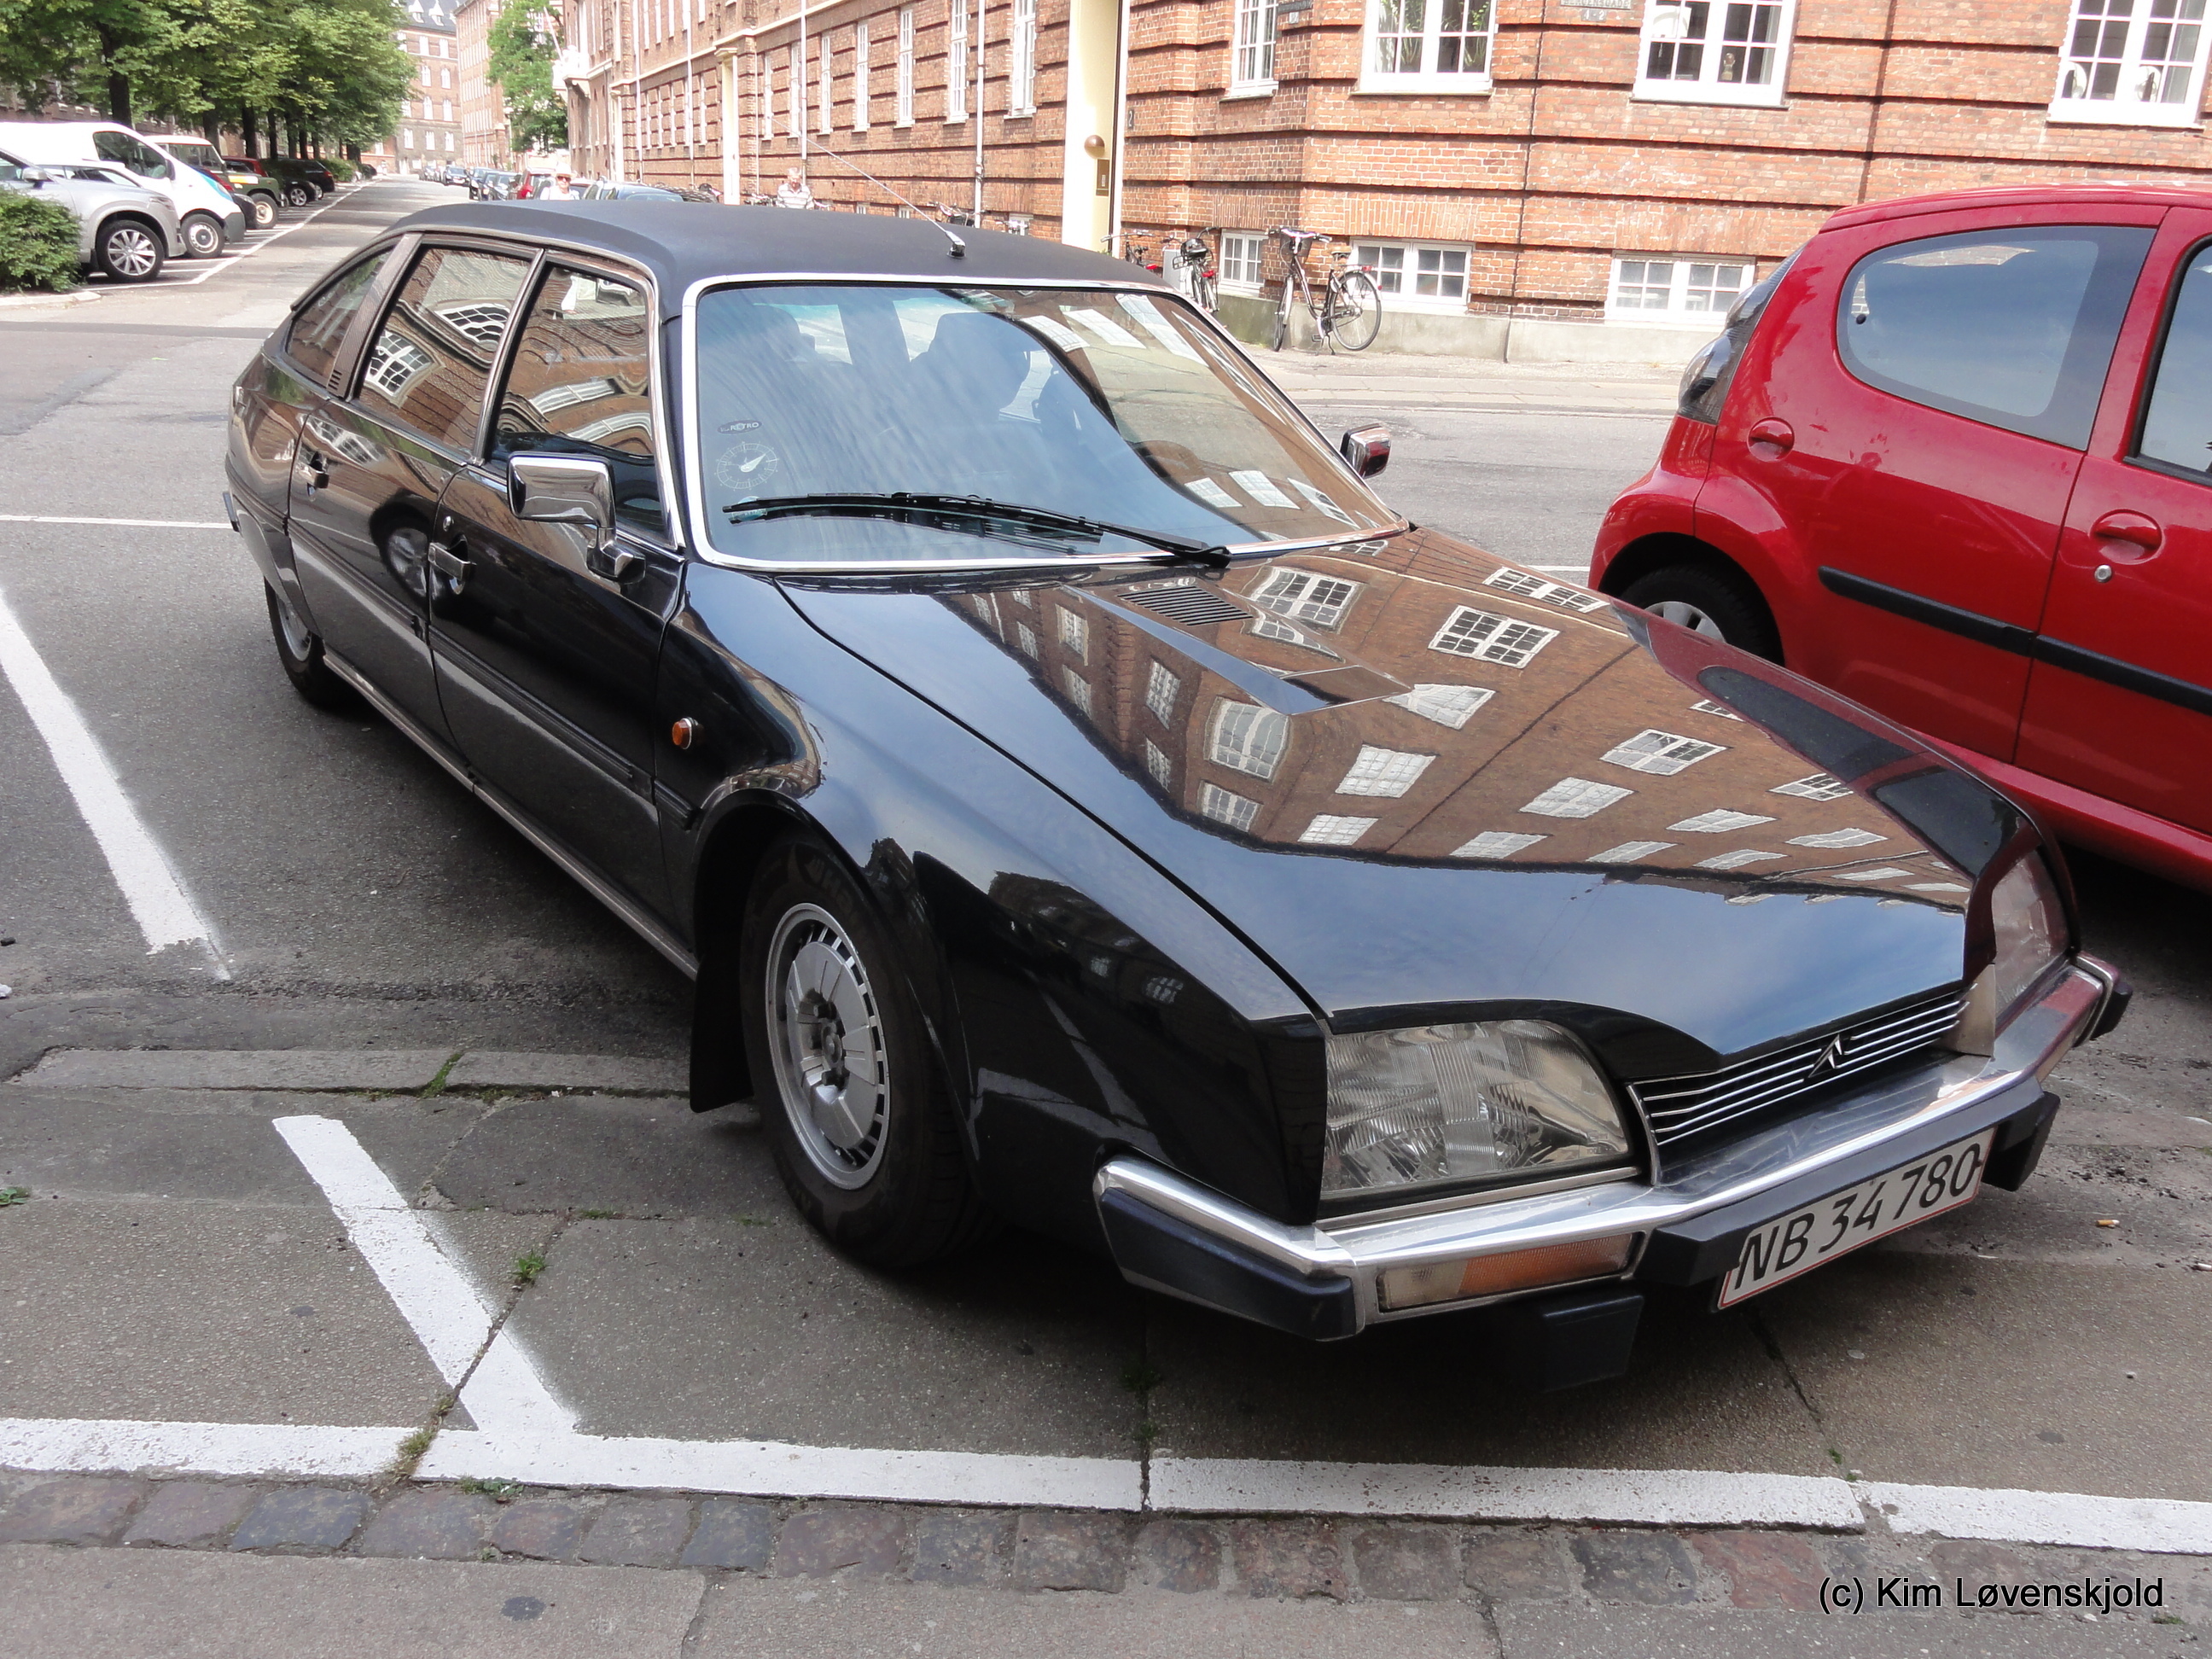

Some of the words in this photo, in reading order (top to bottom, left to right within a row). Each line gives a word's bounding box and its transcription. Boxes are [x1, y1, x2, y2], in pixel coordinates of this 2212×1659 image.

[1734, 1212, 1815, 1290] NB
[1819, 1179, 1888, 1254] 34
[1892, 1142, 1981, 1220] 780
